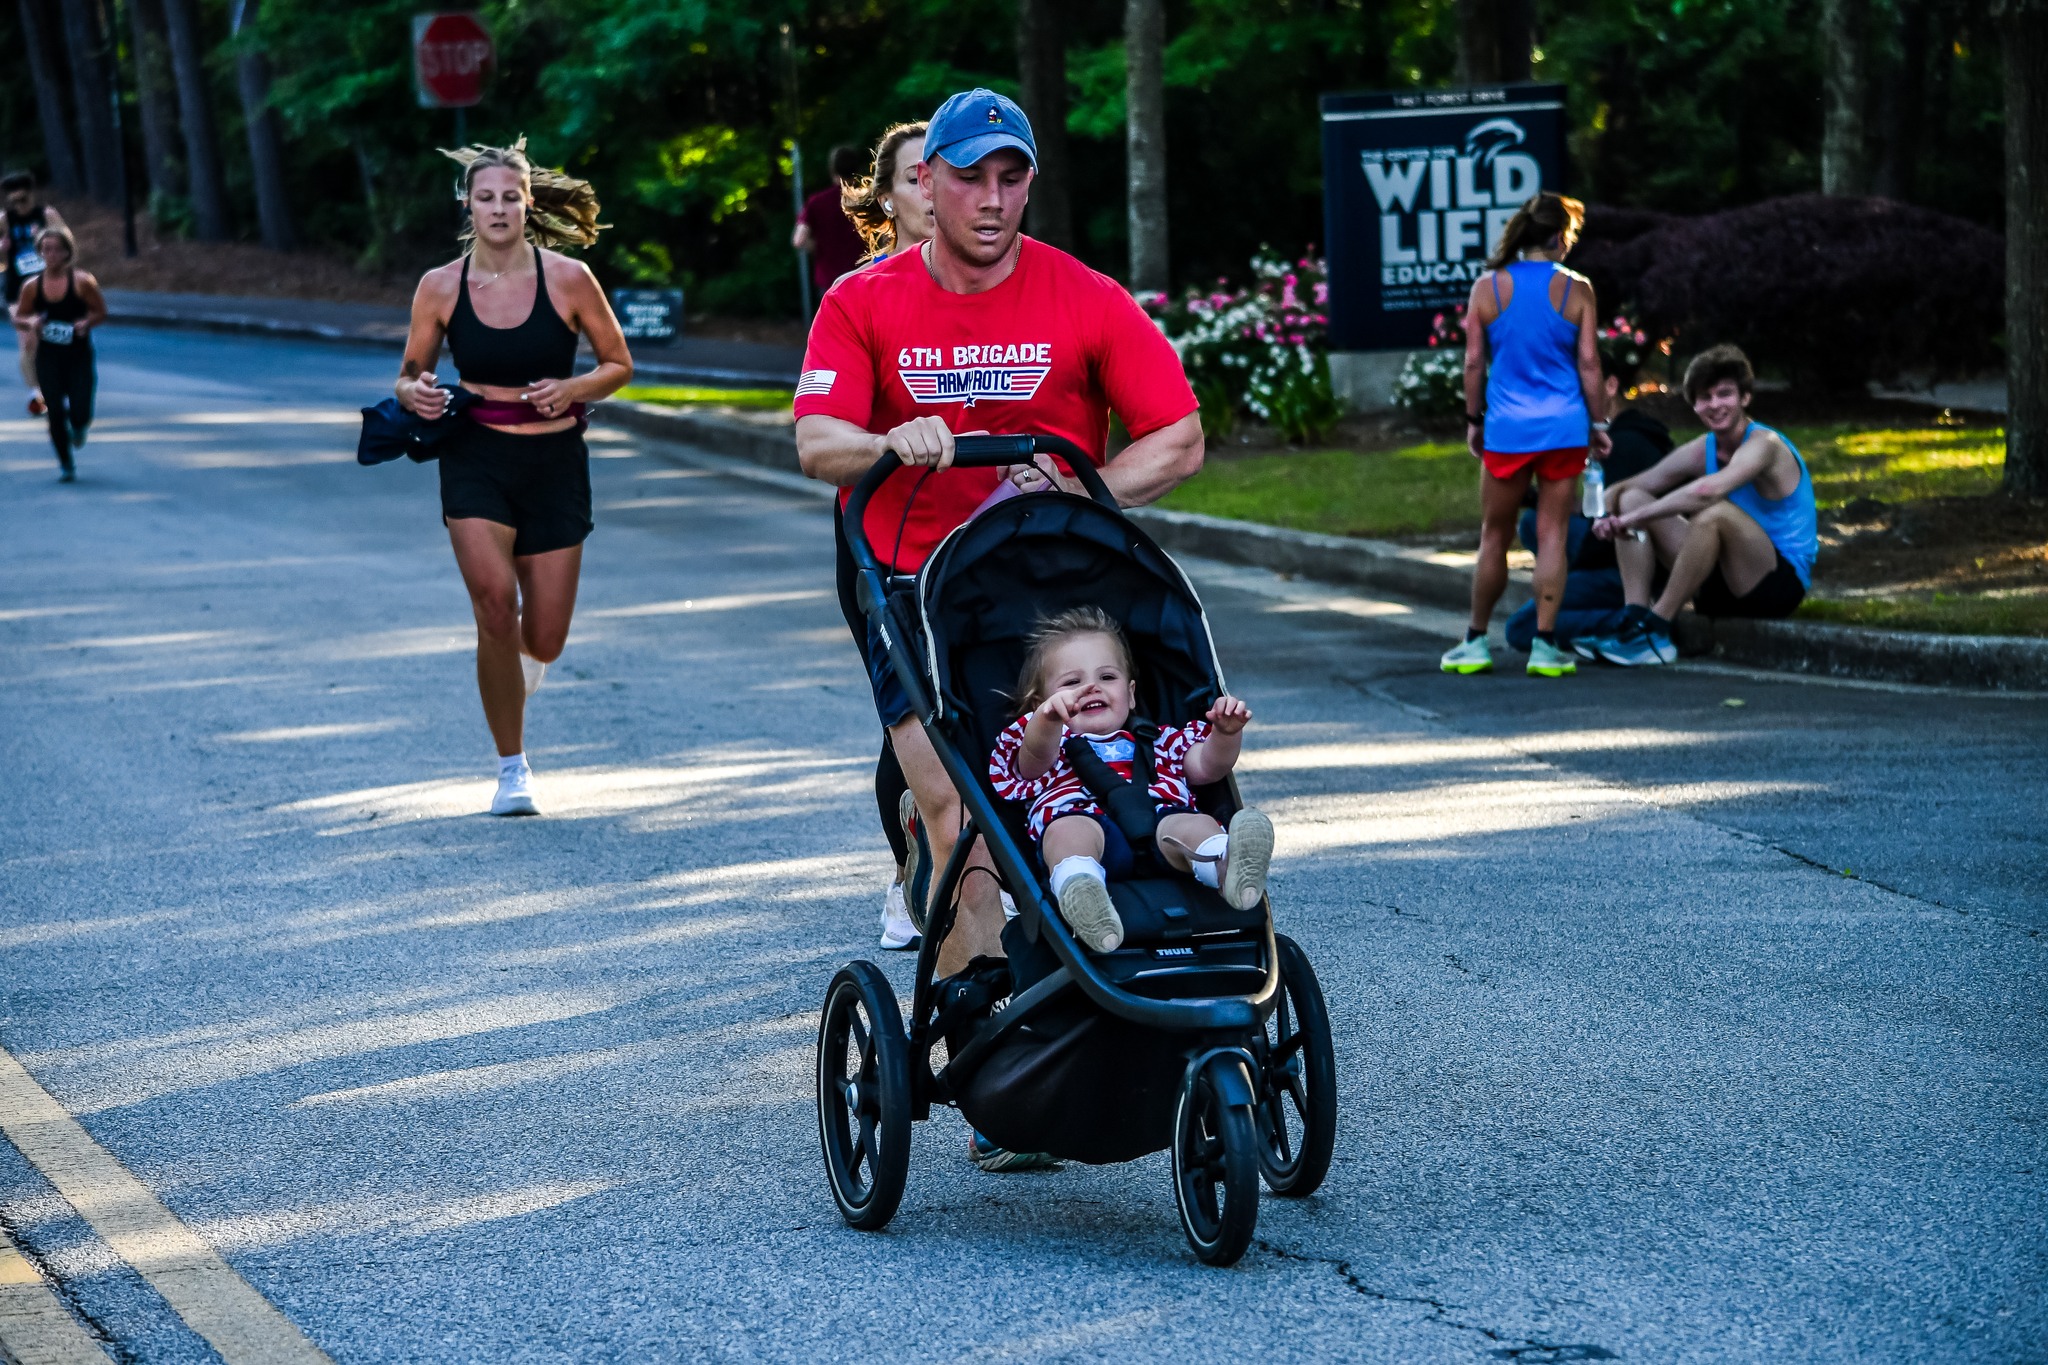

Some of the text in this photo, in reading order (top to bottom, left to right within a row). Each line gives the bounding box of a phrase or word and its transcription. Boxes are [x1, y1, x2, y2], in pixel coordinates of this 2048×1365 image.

[420, 41, 489, 77] STOP
[1362, 153, 1541, 213] WILD
[1382, 262, 1483, 285] EDUCAT
[898, 344, 1052, 367] 6TH BRIGADE
[1156, 947, 1194, 956] THULE
